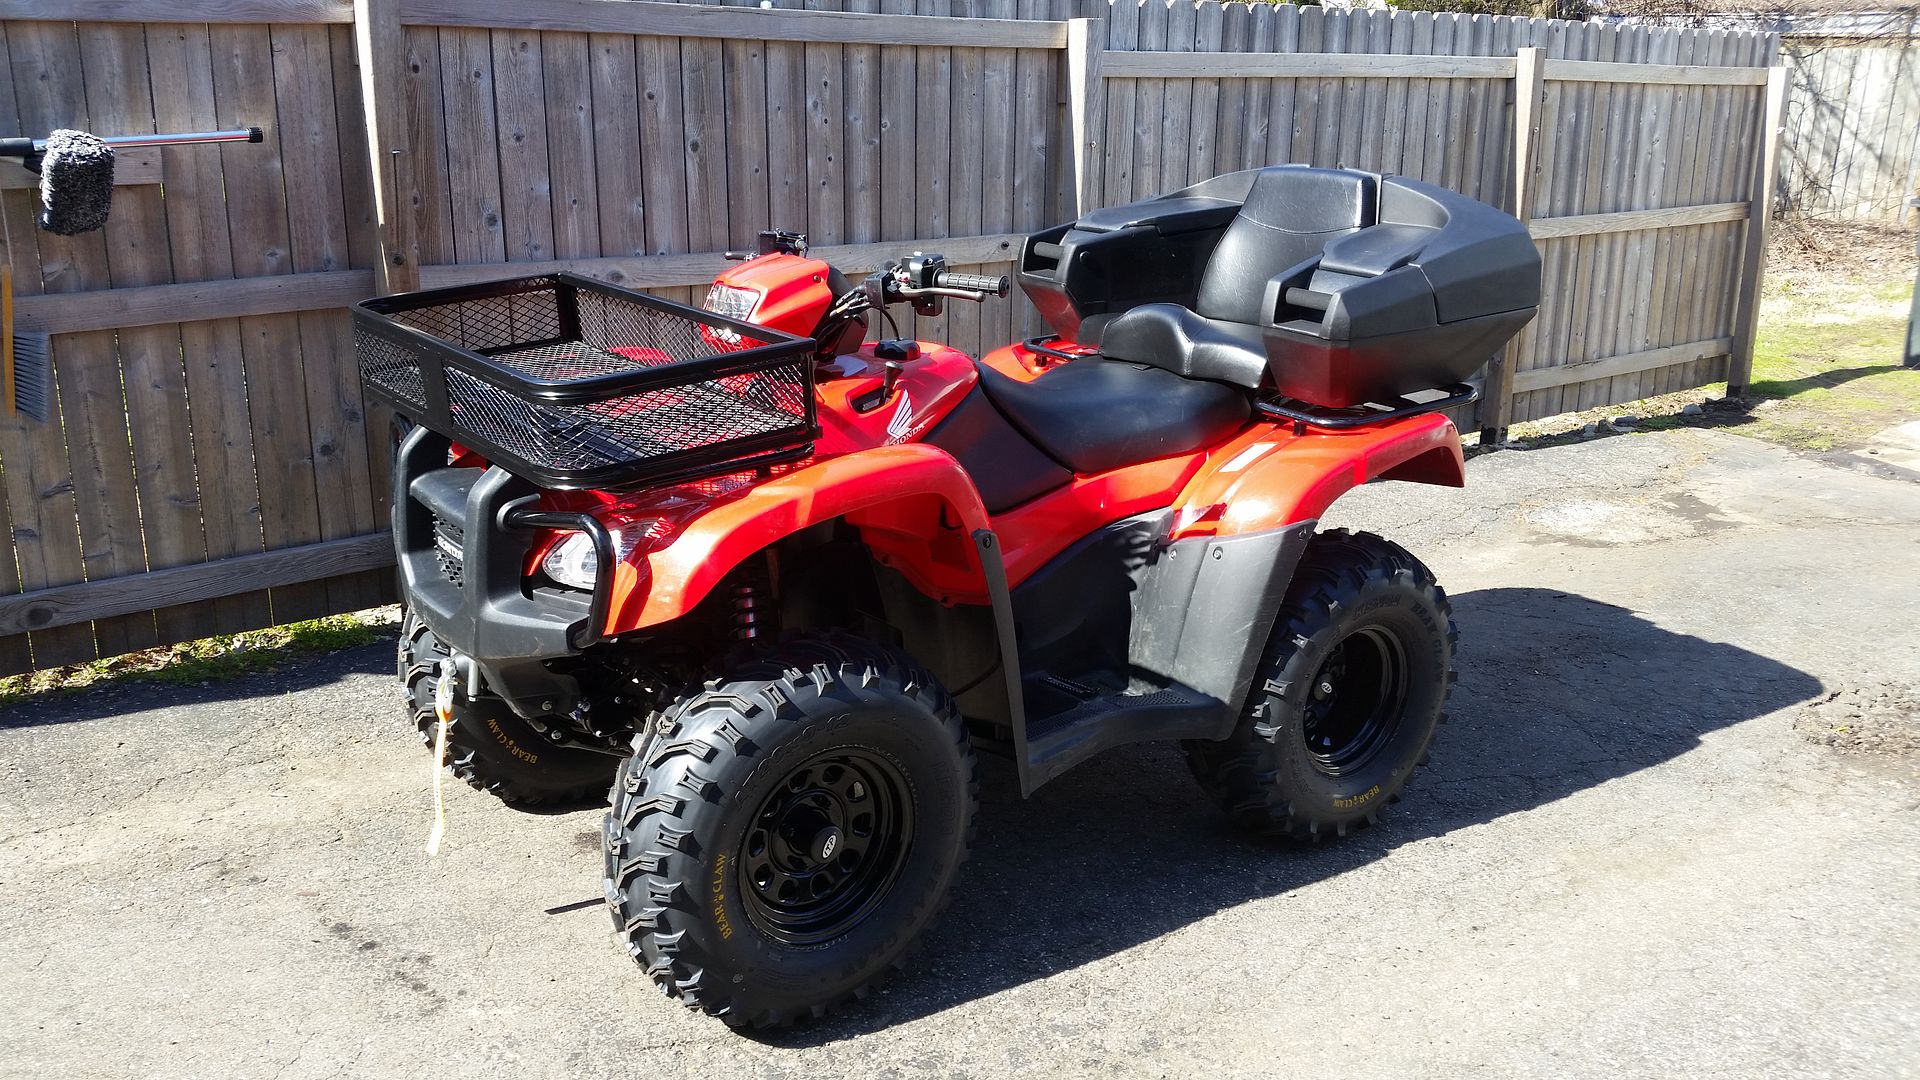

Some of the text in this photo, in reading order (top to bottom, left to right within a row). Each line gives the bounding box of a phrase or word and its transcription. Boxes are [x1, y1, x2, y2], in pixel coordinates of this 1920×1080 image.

[487, 718, 538, 764] BEAR CLAW
[1359, 784, 1380, 804] BEAR
[712, 853, 733, 940] BEAR CLAW
